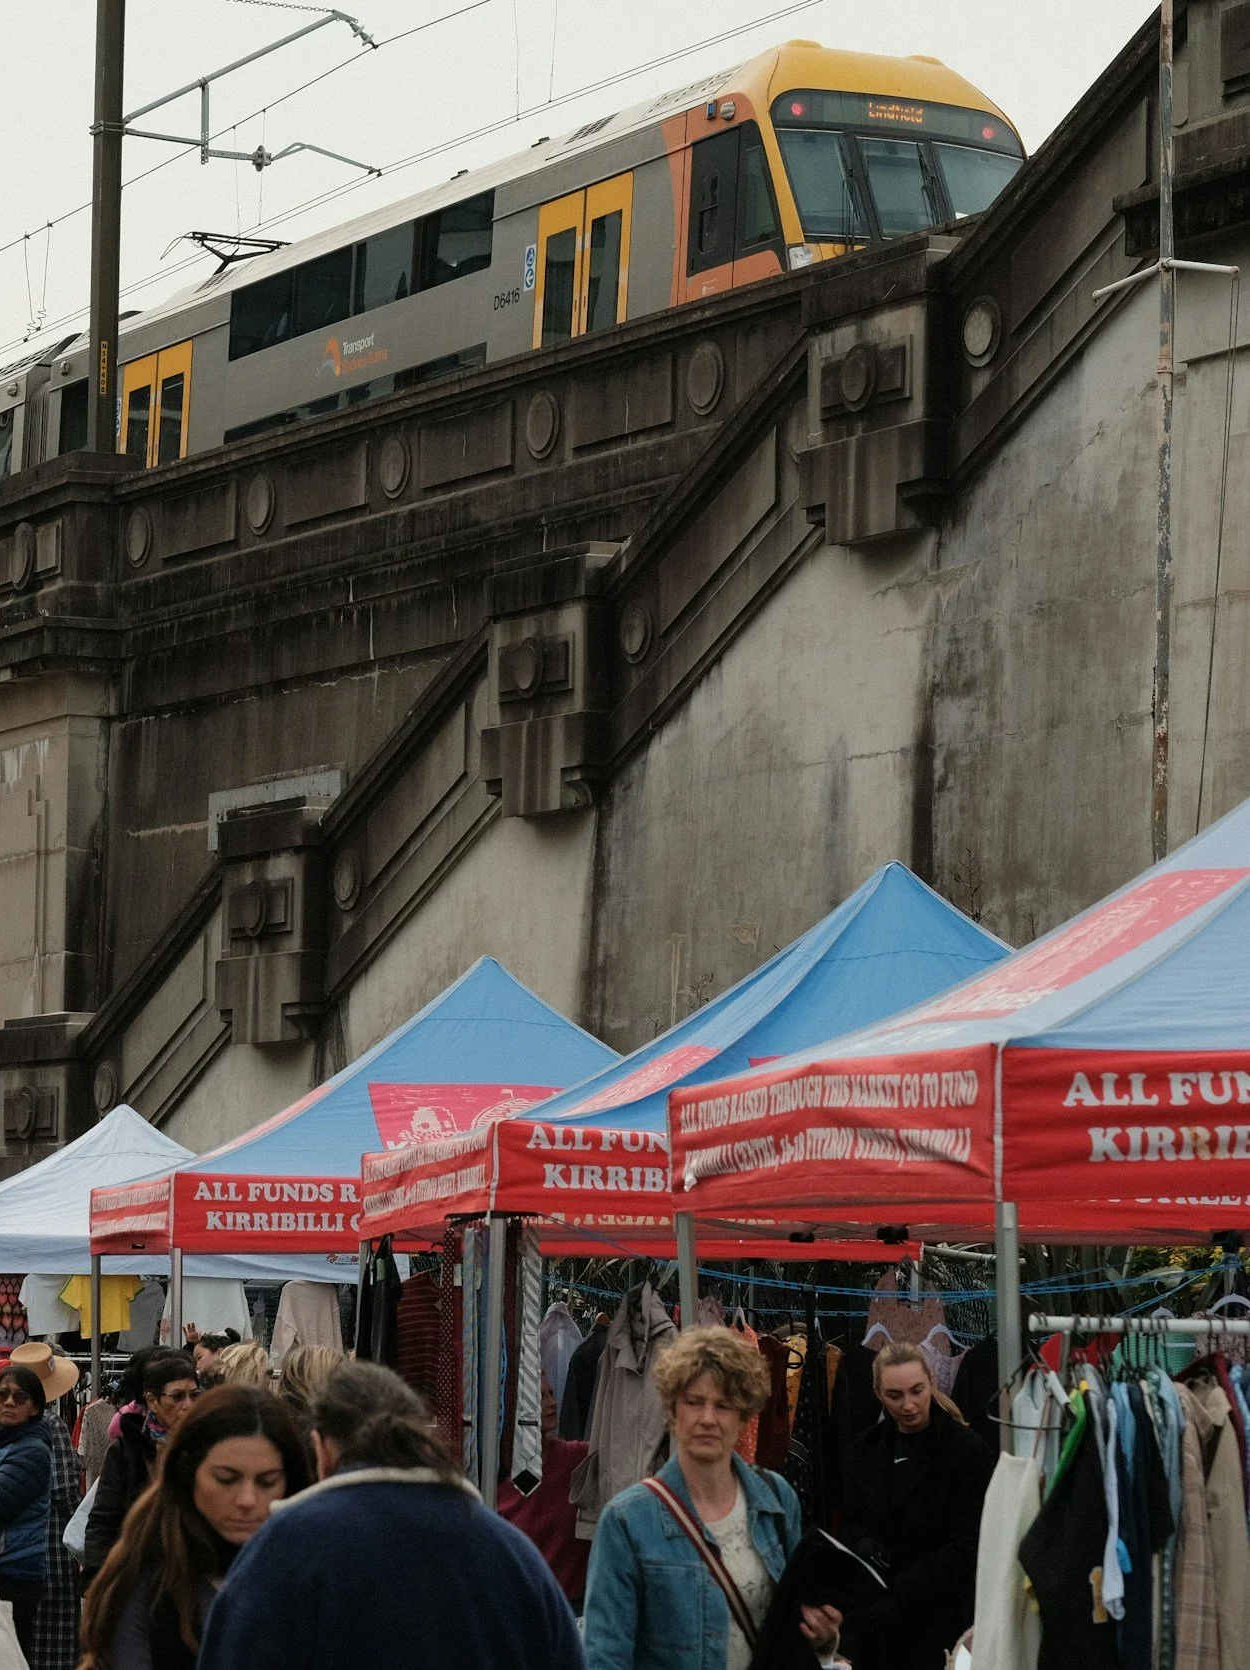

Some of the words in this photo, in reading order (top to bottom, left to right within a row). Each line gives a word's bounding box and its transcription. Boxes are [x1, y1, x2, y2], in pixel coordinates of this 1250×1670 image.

[493, 288, 520, 311] D6416
[343, 332, 375, 356] Transport
[1062, 1071, 1159, 1107] ALL
[680, 1103, 697, 1134] ALL
[698, 1095, 729, 1131] FUNDS
[729, 1086, 768, 1125] RAISED
[768, 1074, 822, 1116] THROUGH
[822, 1074, 850, 1107] THIS
[851, 1074, 900, 1108] MARKET
[902, 1073, 920, 1108] GO
[921, 1072, 939, 1108] TO
[940, 1070, 979, 1108] FUND
[526, 1125, 593, 1150] ALL
[734, 1135, 780, 1173] CENTRE,
[805, 1127, 854, 1160] FITZROY
[854, 1127, 905, 1168] STREET,
[194, 1181, 242, 1202] ALL
[247, 1182, 335, 1203] FUNDS
[205, 1210, 344, 1233] KIRRIBILLI
